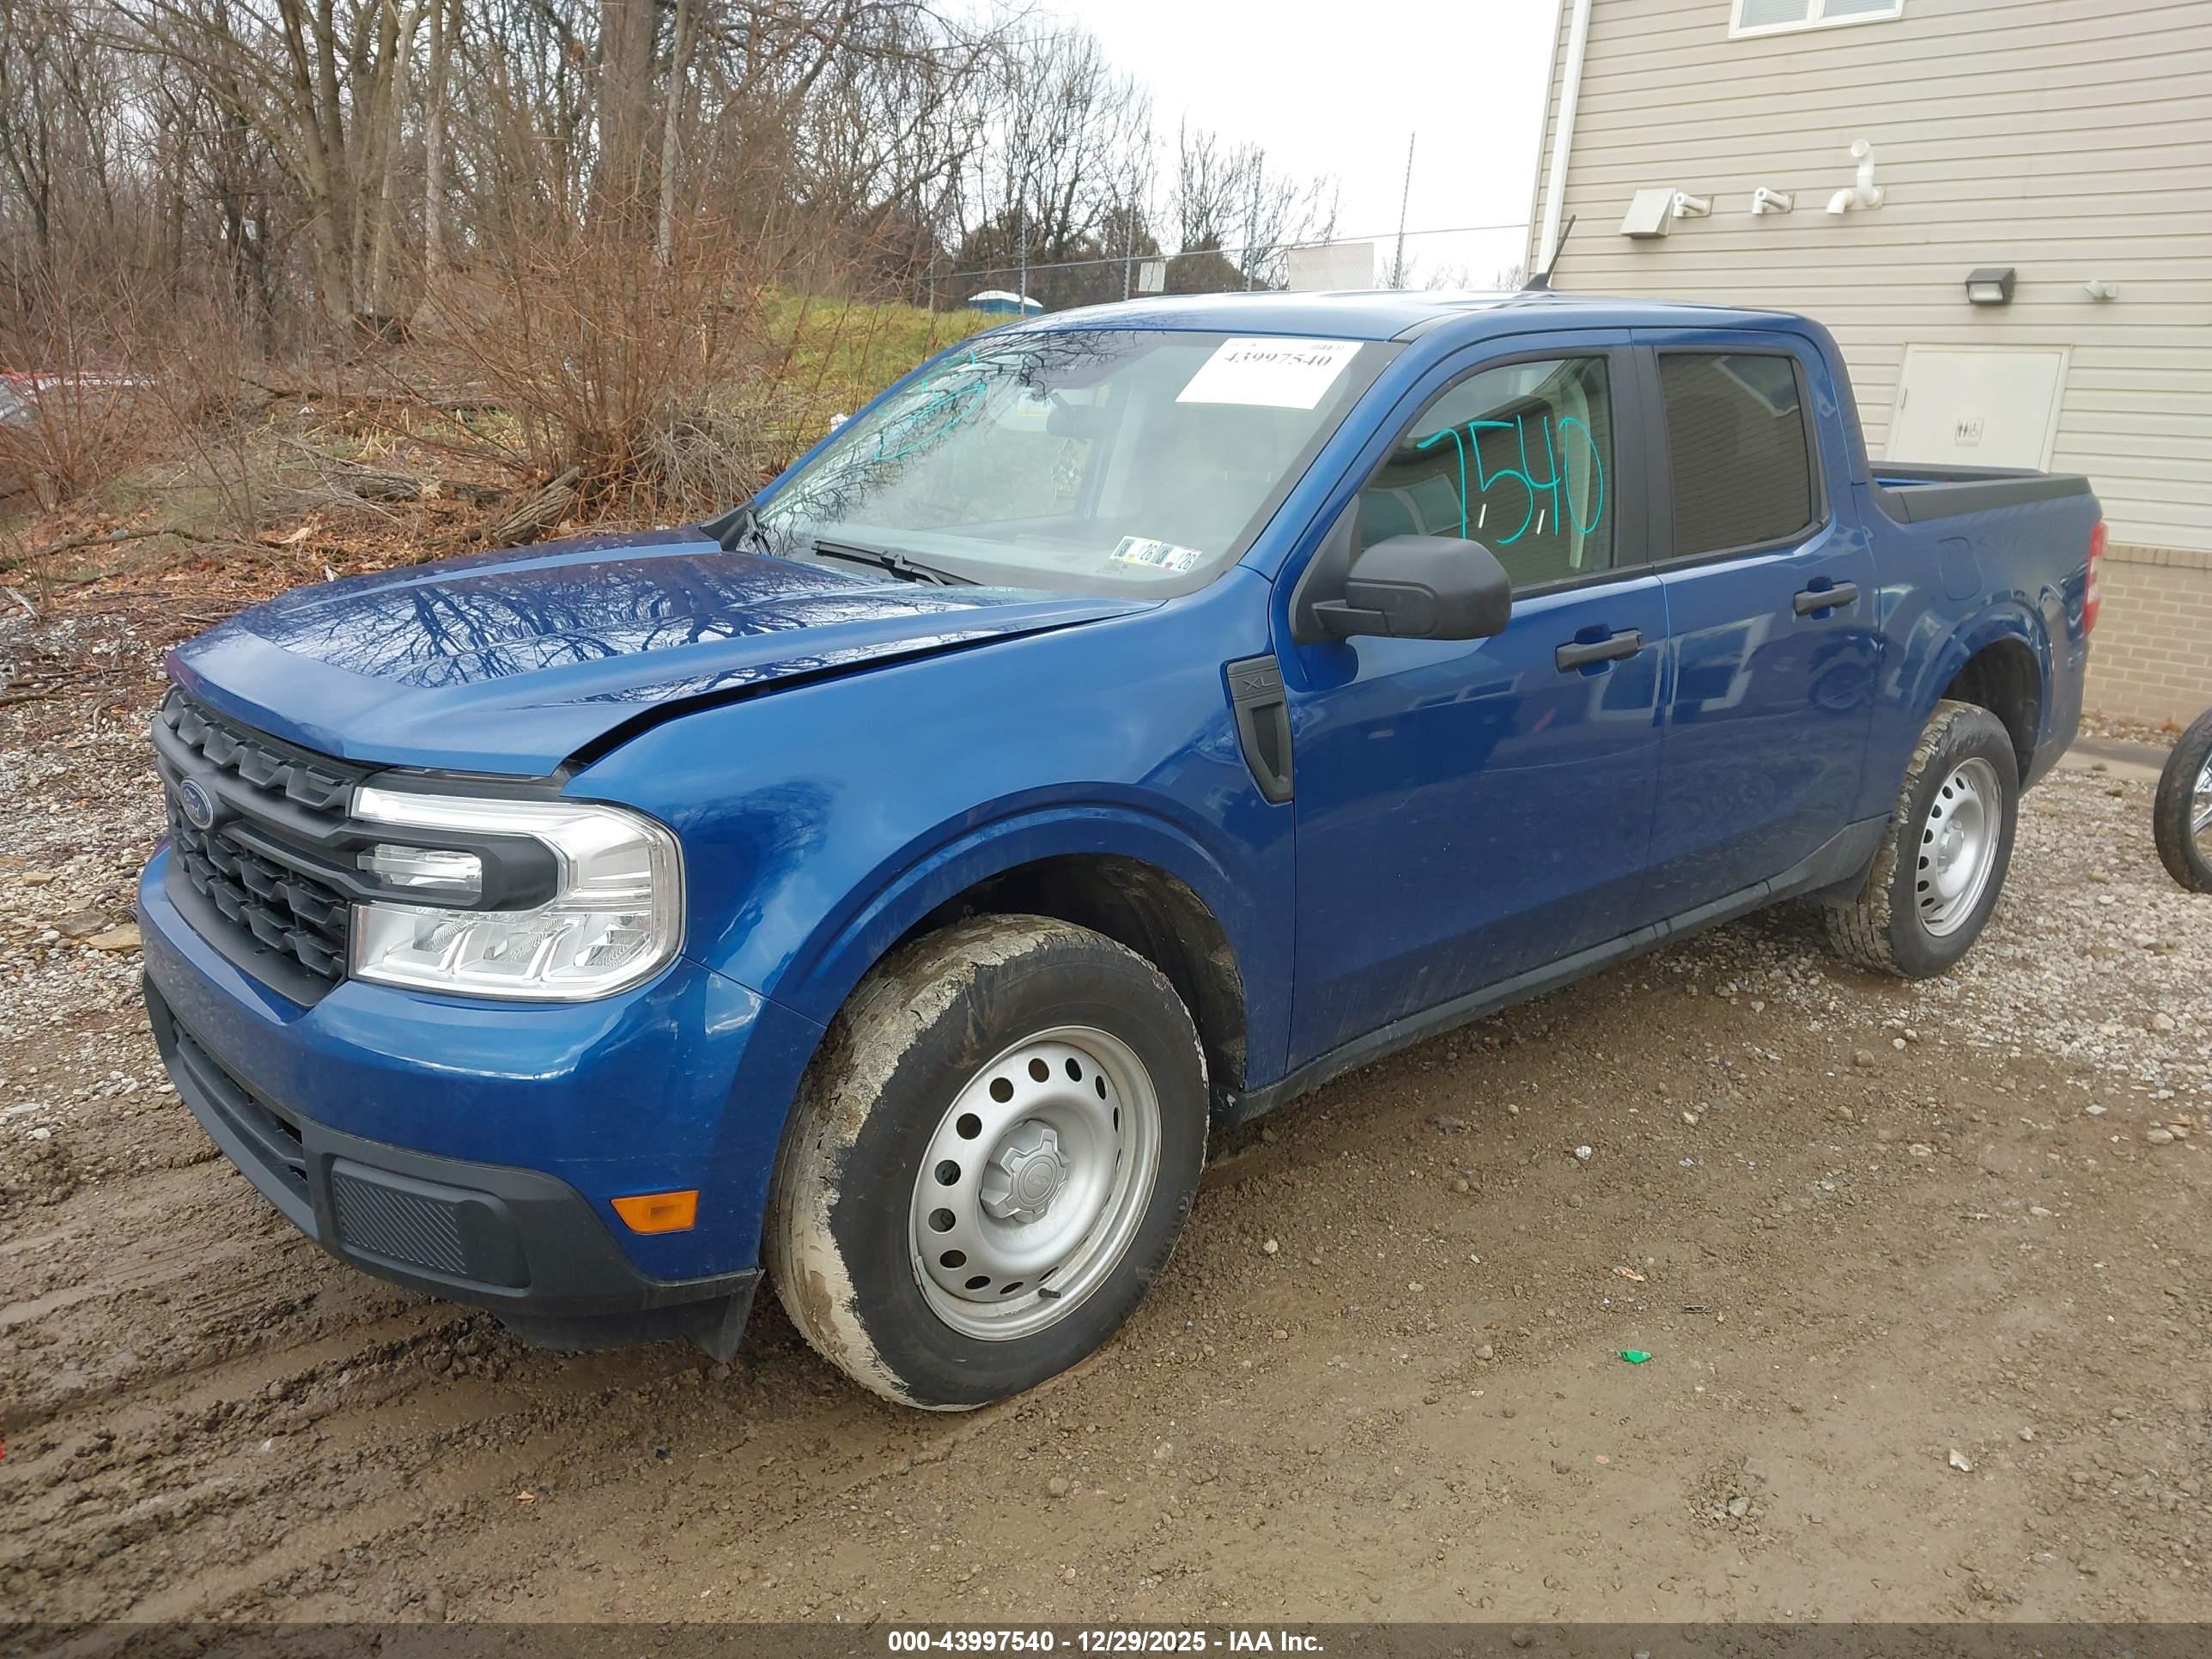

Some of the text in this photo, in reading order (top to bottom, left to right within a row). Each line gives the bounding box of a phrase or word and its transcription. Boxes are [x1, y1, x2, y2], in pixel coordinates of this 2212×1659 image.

[1417, 414, 1604, 544] 7540
[1177, 552, 1197, 570] 26
[1243, 676, 1276, 690] XL
